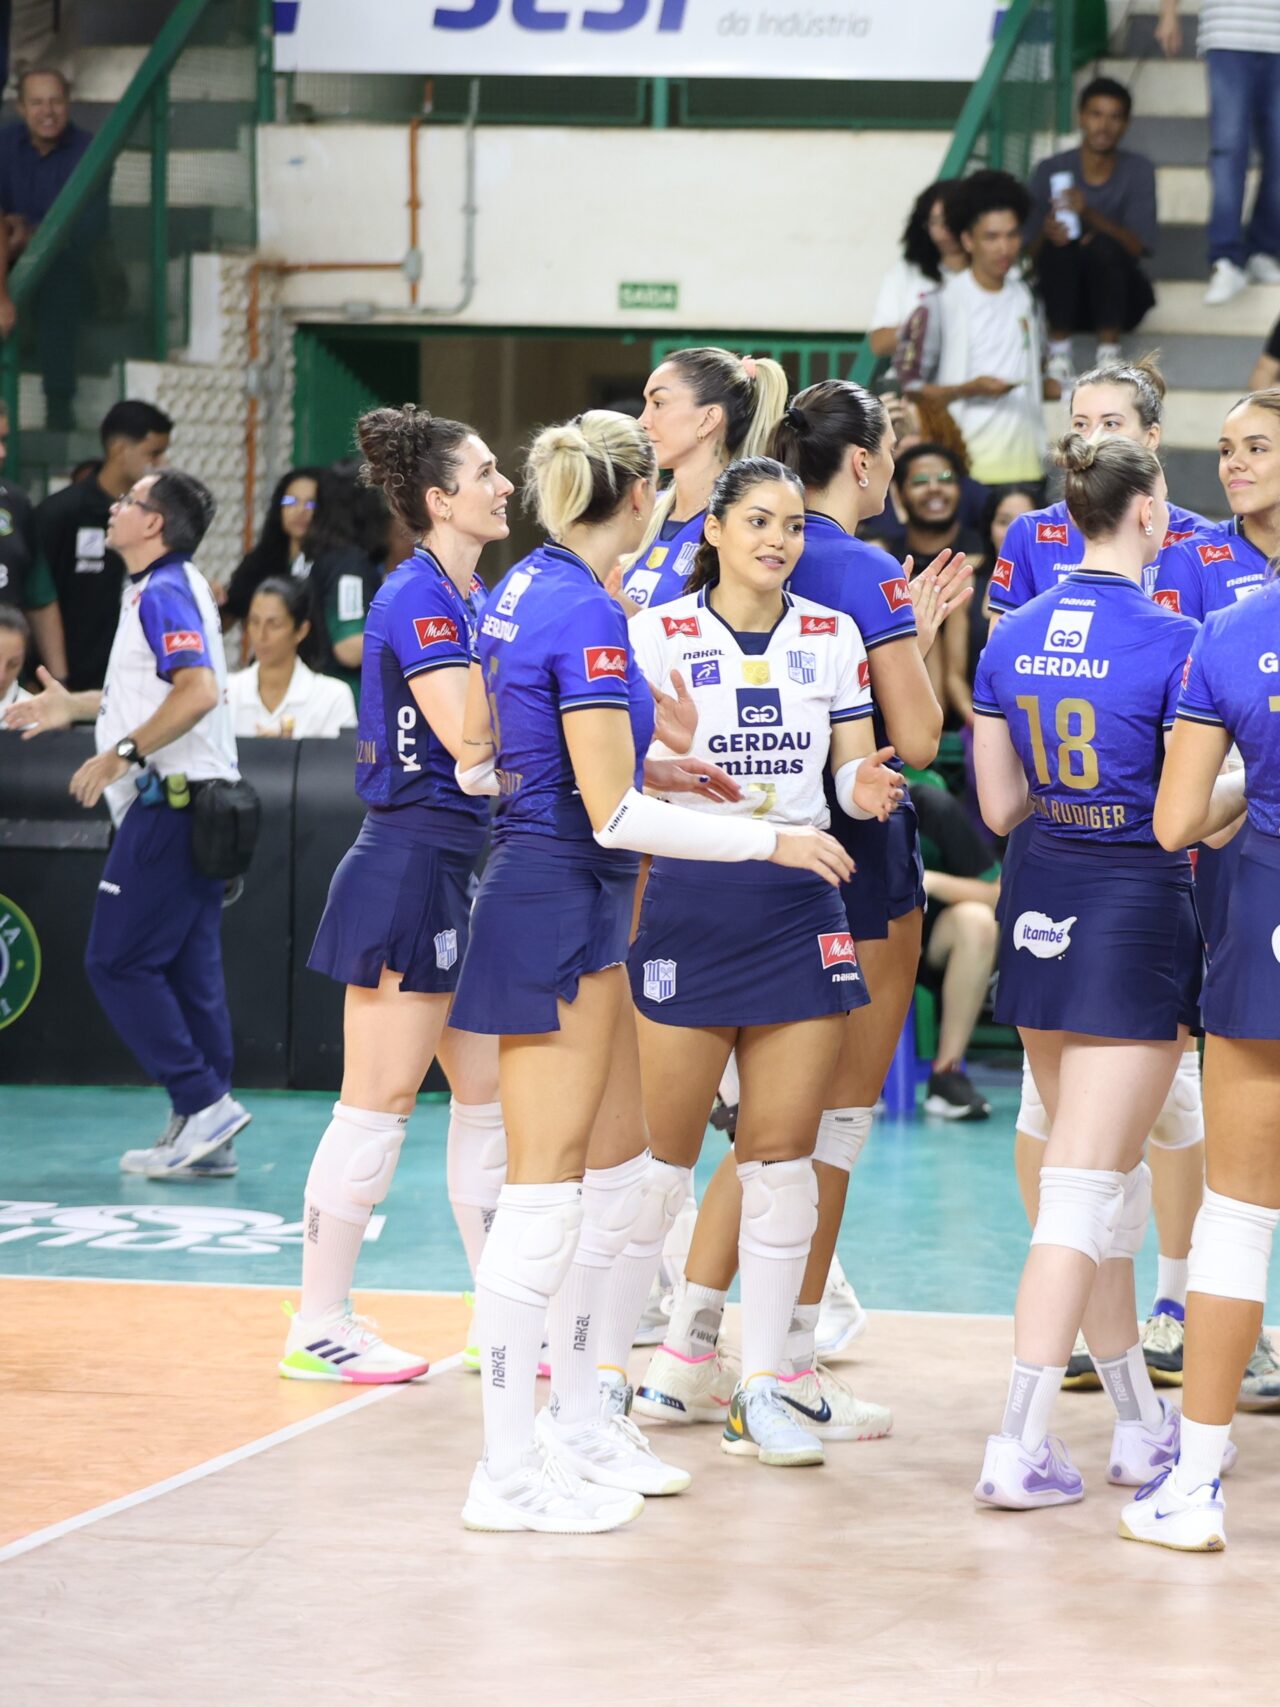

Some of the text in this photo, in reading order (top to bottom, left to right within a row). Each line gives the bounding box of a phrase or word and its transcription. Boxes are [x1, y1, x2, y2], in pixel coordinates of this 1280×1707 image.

[1014, 654, 1110, 679] GERDAU
[397, 705, 422, 773] KTO
[708, 731, 812, 754] GERDAU
[1015, 694, 1100, 790] 18
[715, 754, 804, 776] minas
[1051, 799, 1126, 830] RUDIGER
[1022, 924, 1065, 943] itambé
